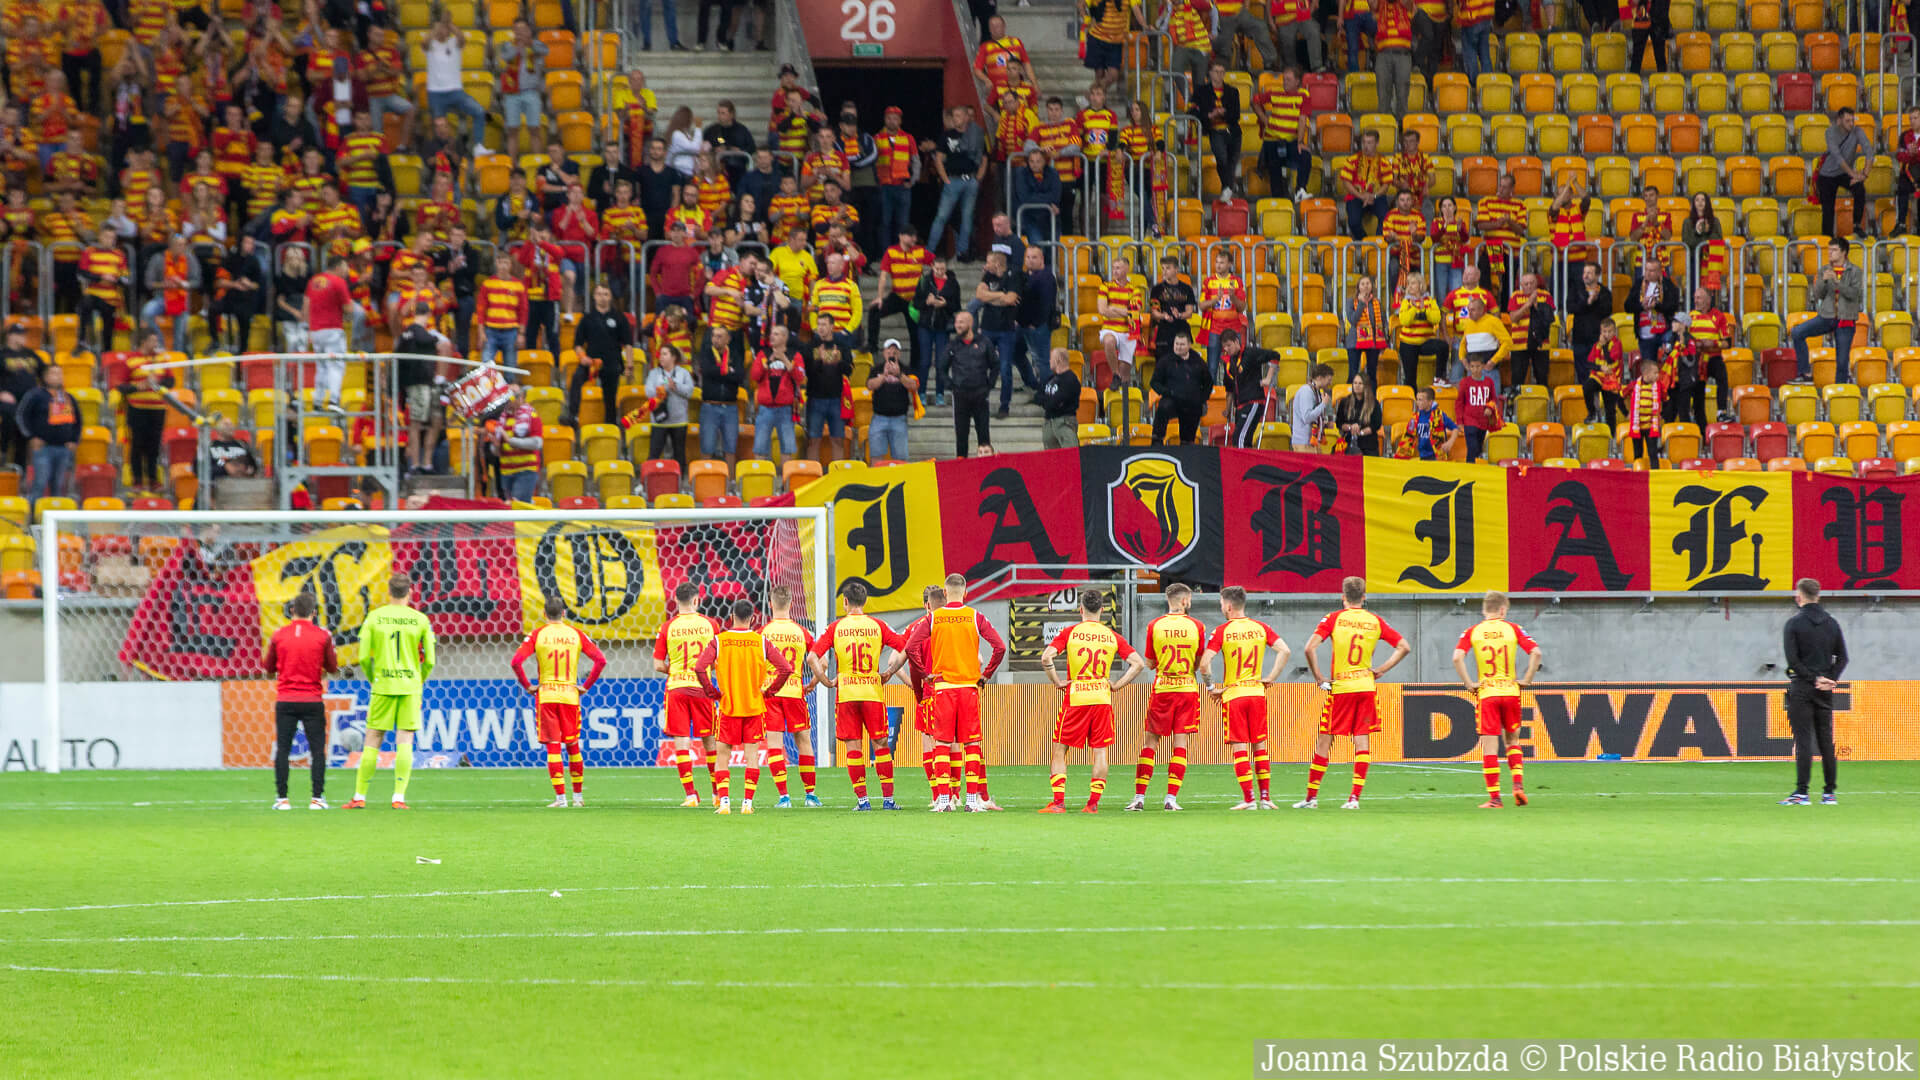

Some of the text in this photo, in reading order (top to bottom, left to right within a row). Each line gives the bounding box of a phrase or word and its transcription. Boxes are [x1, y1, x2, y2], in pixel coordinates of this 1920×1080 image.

[841, 0, 896, 40] 26
[1469, 386, 1490, 406] GAP
[390, 631, 400, 662] 1
[838, 628, 879, 637] BORYSIUK
[1072, 632, 1115, 643] POSPISIL
[1164, 629, 1188, 638] TIRU
[1226, 630, 1265, 641] PRIKRYL
[547, 649, 571, 681] 11
[845, 642, 873, 674] 16
[1077, 647, 1108, 680] 26
[1162, 644, 1192, 676] 25
[1231, 645, 1258, 680] 14
[1348, 633, 1364, 666] 6
[1481, 644, 1509, 677] 31
